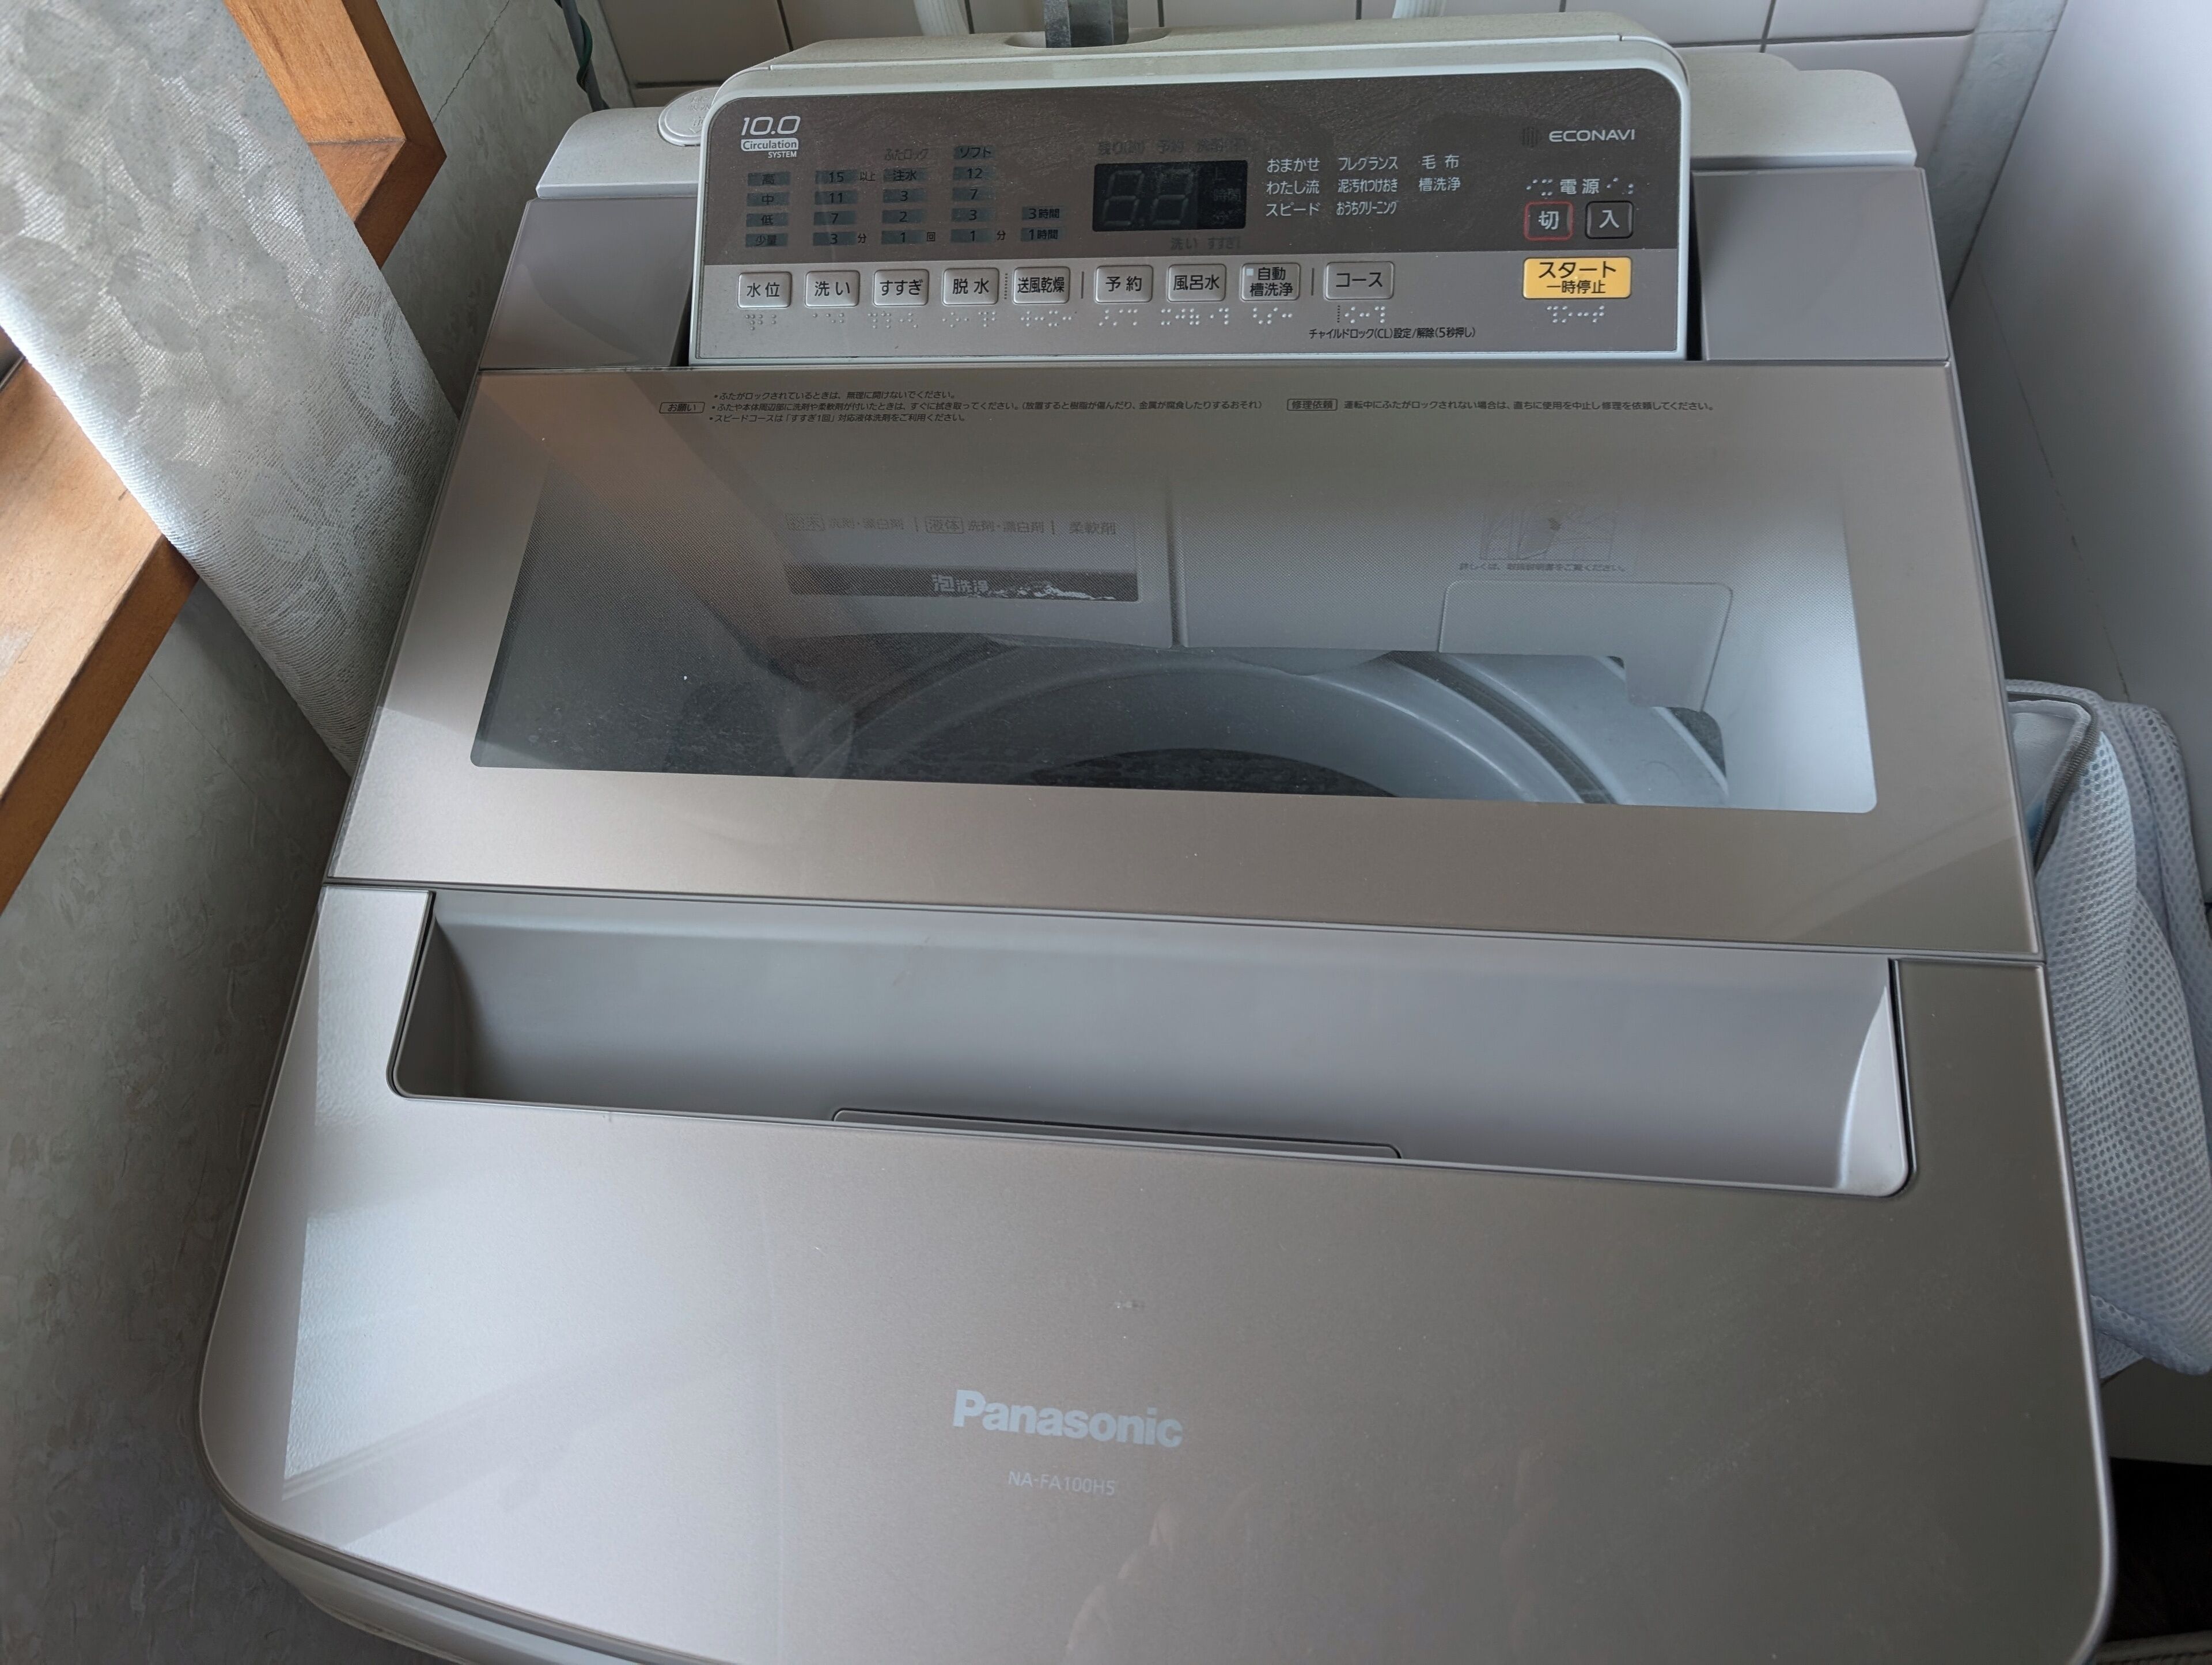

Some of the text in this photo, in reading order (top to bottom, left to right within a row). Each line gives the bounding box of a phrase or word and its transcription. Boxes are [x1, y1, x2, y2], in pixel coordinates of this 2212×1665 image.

[741, 115, 801, 136] 10.0
[1548, 129, 1635, 142] ECONAVI
[743, 139, 797, 150] Circulation
[768, 150, 797, 158] SYSTEM
[959, 146, 991, 159] ソフト
[1267, 157, 1320, 173] おまかせ
[1338, 156, 1398, 171] フレグランス
[1421, 154, 1460, 169] 毛布
[828, 171, 876, 183] 15 以上
[892, 169, 917, 182] 注水
[966, 168, 983, 179] 12
[1266, 179, 1320, 195] わたし流
[1338, 178, 1398, 194] 泥汚れつけおき
[1418, 176, 1461, 192] 槽洗浄
[1559, 178, 1600, 195] 電源
[760, 194, 775, 206] 中
[829, 192, 843, 203] 11
[900, 190, 909, 202] 3
[969, 188, 978, 200] 7
[968, 209, 978, 221] 3
[1266, 202, 1321, 217] スピード
[1336, 201, 1397, 216] おうちクリーニング
[760, 214, 774, 226] 低
[831, 213, 839, 224] 7
[899, 211, 908, 222] 2
[1538, 211, 1559, 230] 切
[1599, 210, 1620, 229] 入
[755, 235, 778, 247] 少量
[830, 233, 867, 245] 3 分
[900, 232, 936, 244] 1 回
[970, 230, 1006, 242] 1 分
[1257, 267, 1286, 280] 自動
[1538, 261, 1616, 279] スタート
[952, 278, 989, 295] 脱水
[1017, 276, 1065, 294] 送風乾燥
[1105, 276, 1142, 292] 予約
[1173, 274, 1220, 291] 風呂水
[1335, 272, 1383, 287] コース
[1546, 279, 1606, 294] 一時停止
[747, 282, 780, 298] 水位
[815, 280, 850, 297] 洗い
[880, 279, 923, 296] すすぎ
[1249, 282, 1294, 297] 槽洗浄
[668, 403, 696, 412] お願い
[1291, 401, 1334, 410] 修理依頼
[952, 1389, 1183, 1448] Panasonic
